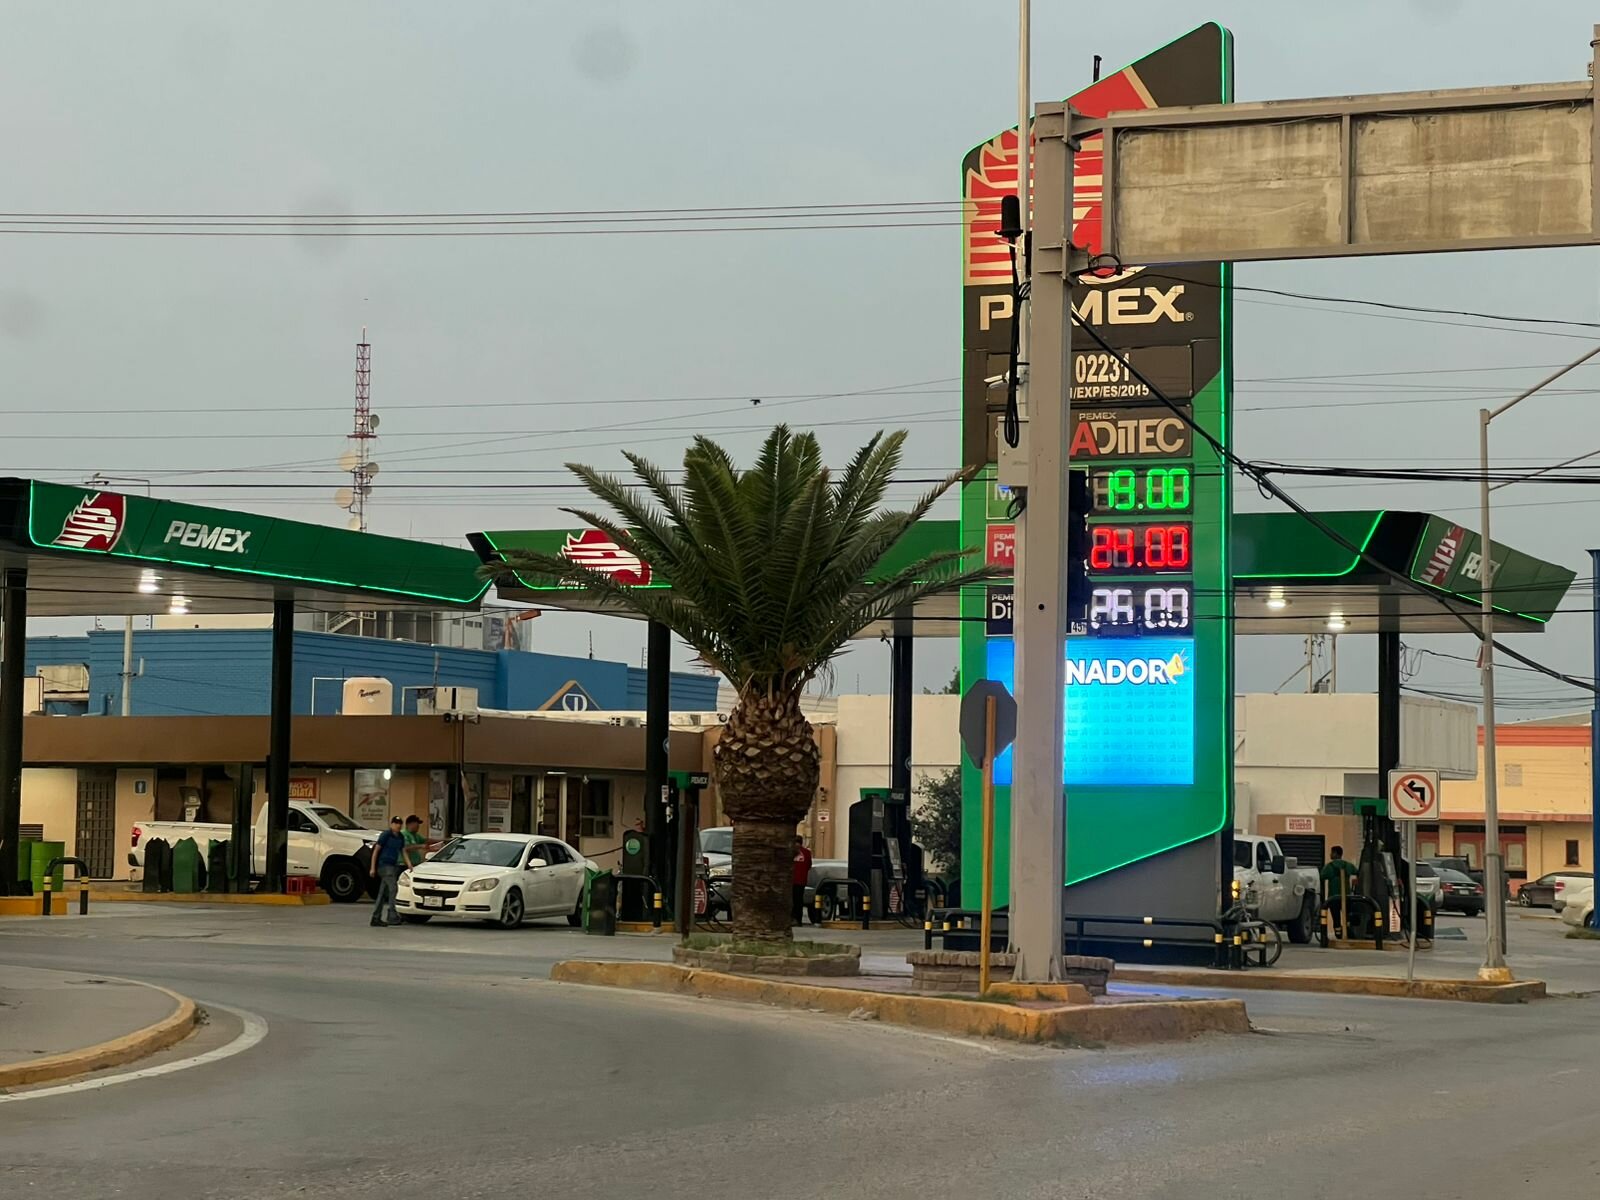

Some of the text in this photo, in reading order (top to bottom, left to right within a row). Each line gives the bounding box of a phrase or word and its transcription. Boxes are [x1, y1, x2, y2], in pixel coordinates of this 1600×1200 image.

[980, 284, 1185, 331] PMEX
[1075, 353, 1130, 384] 02231
[1079, 412, 1117, 421] PEMEX
[1108, 468, 1190, 510] 19.00
[164, 520, 250, 553] PEMEX
[1091, 527, 1189, 569] 24.00
[1065, 659, 1168, 684] NADOR
